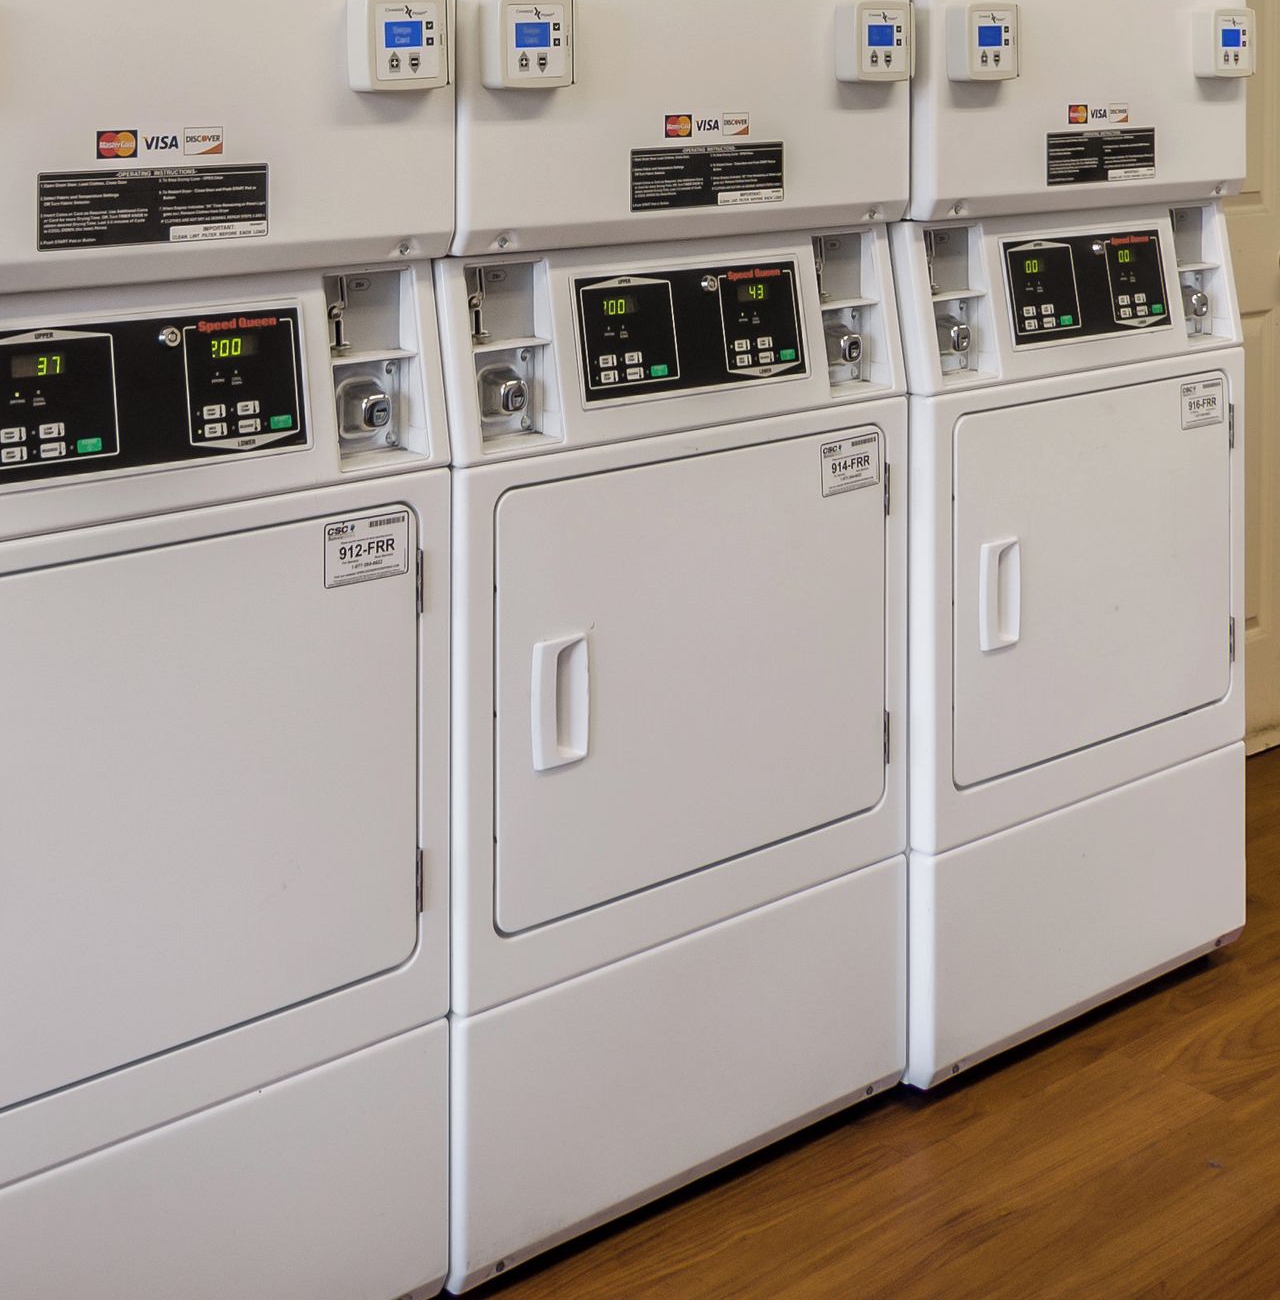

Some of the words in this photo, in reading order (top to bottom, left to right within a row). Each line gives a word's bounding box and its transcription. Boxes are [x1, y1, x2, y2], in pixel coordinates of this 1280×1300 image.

[1091, 108, 1107, 118] VISA
[696, 120, 719, 131] VISA
[144, 136, 179, 150] VISA
[186, 135, 220, 143] DISCOVER
[1026, 260, 1038, 273] 00
[749, 284, 763, 299] 43
[198, 318, 236, 333] Speed
[239, 317, 276, 328] Queen
[38, 356, 60, 376] 37
[823, 446, 837, 454] CSC
[832, 455, 870, 474] 914-FRR
[327, 525, 348, 536] CSC
[339, 538, 395, 560] 912-FRR
